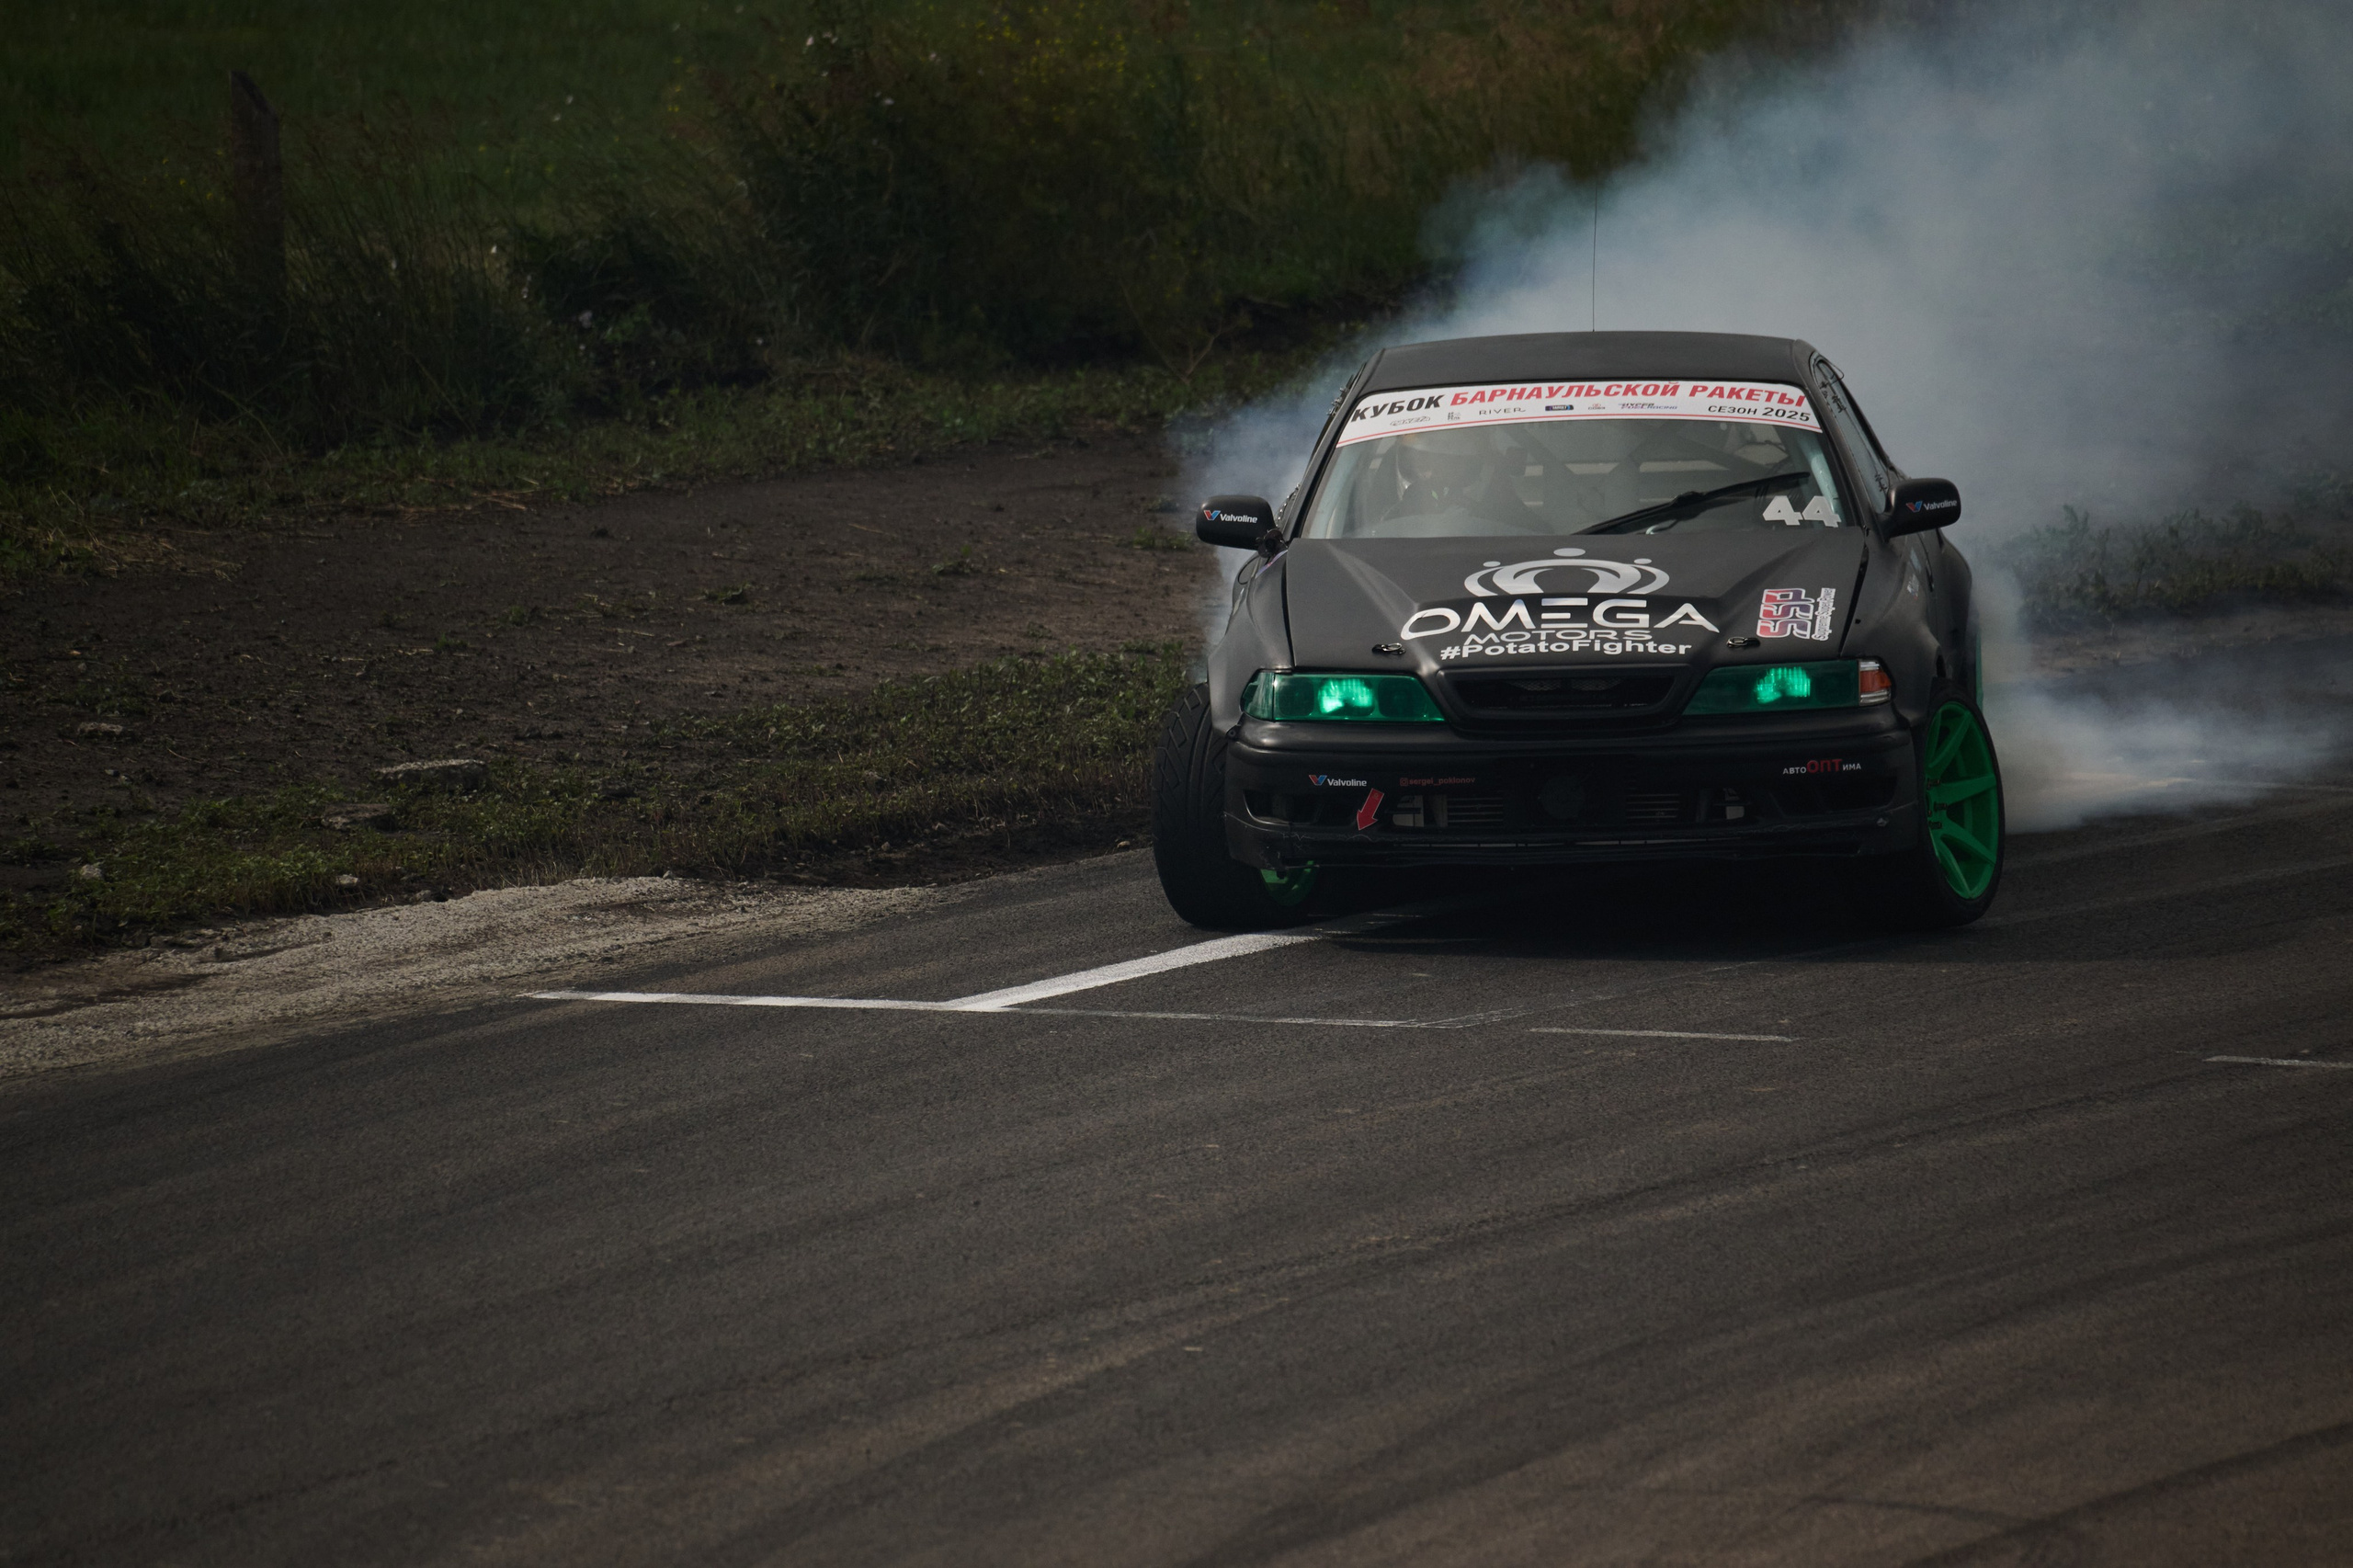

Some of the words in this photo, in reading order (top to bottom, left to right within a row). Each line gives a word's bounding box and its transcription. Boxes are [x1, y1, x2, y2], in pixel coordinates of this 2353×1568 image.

[1351, 394, 1445, 423] КУБОК
[1449, 381, 1681, 406] БАРНАУЛЬСКОЙ
[1688, 384, 1807, 407] РАКЕТЫ
[1708, 404, 1757, 415] СЕЗОН
[1762, 406, 1812, 422] 2025
[1762, 495, 1842, 528] 44
[1923, 500, 1958, 511] Valvoline
[1220, 513, 1258, 524] Valvoline
[1400, 597, 1721, 641] OMEGA
[1463, 630, 1653, 645] MOTORS
[1440, 640, 1692, 660] #PotatoFighter
[1327, 778, 1368, 787] Valvoline
